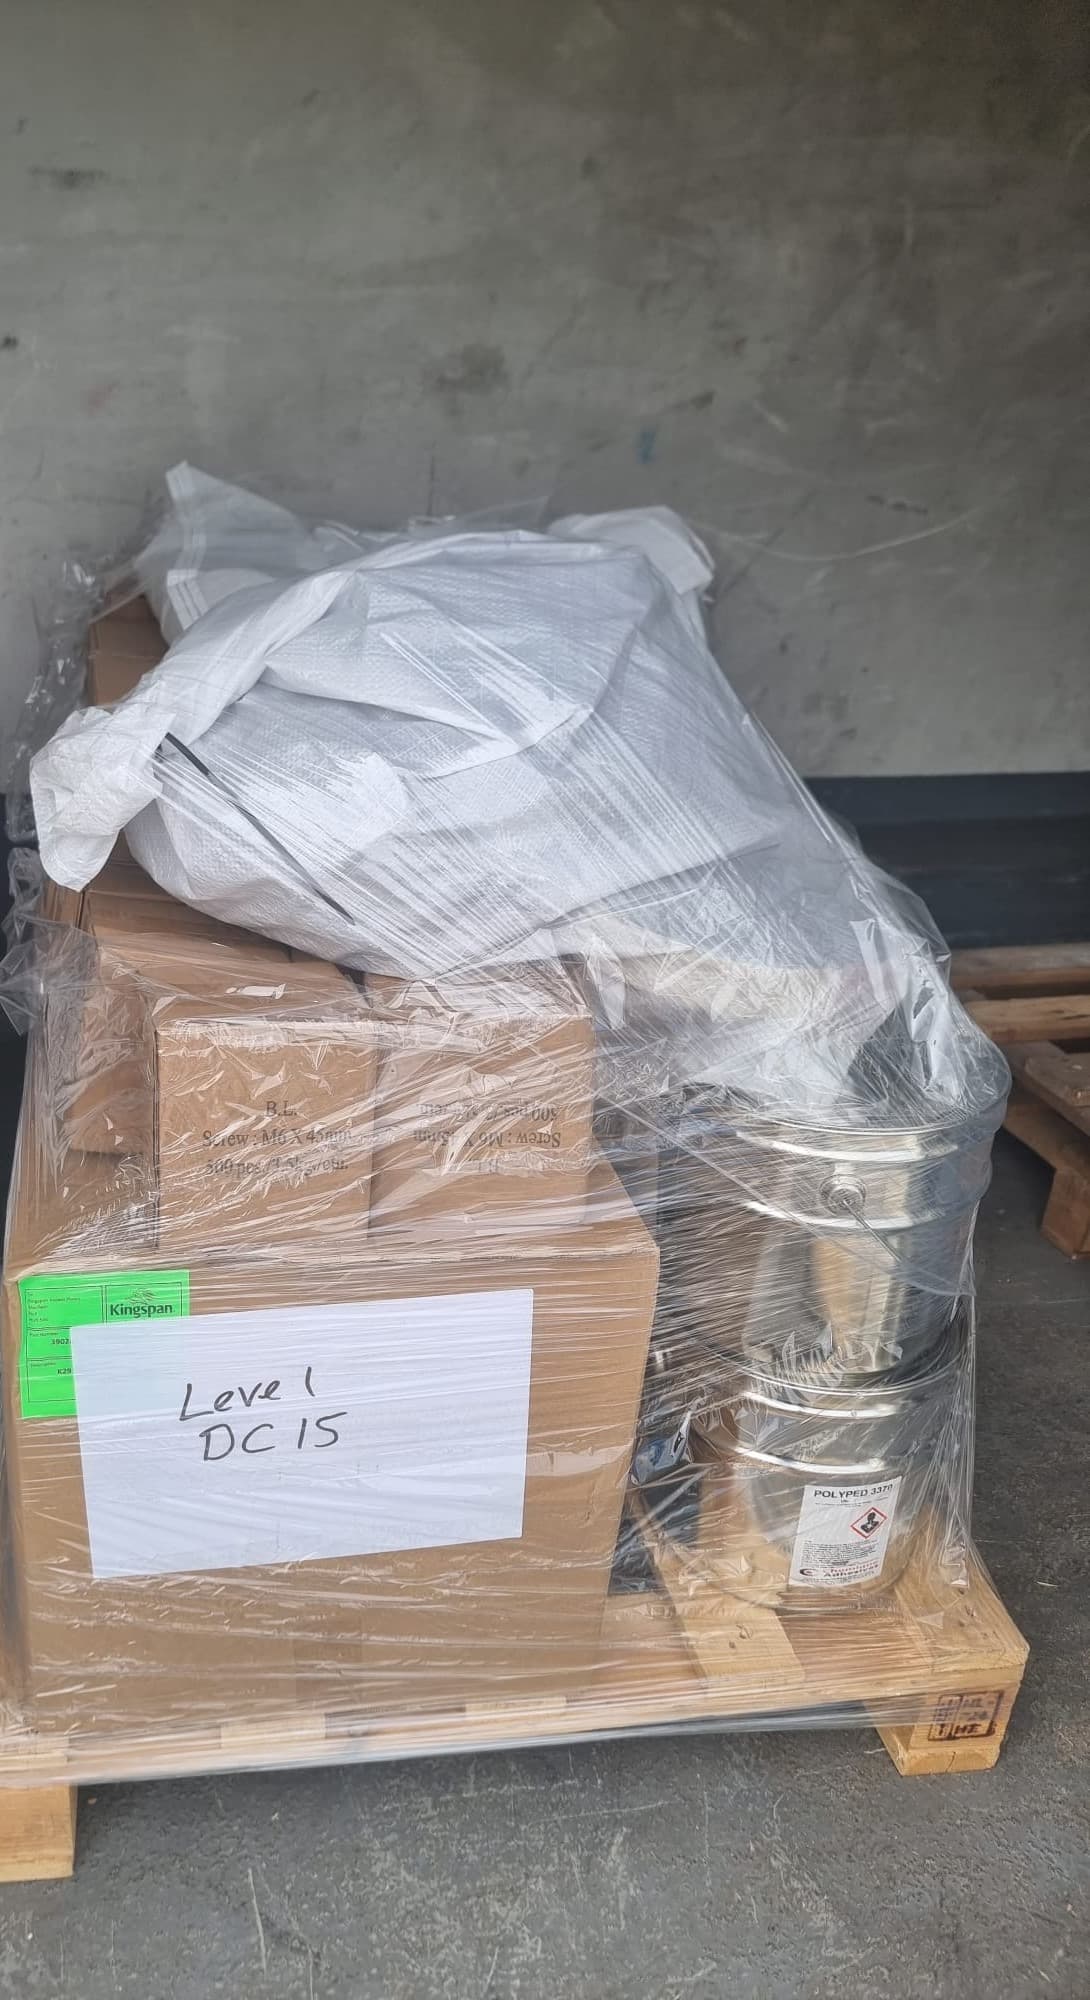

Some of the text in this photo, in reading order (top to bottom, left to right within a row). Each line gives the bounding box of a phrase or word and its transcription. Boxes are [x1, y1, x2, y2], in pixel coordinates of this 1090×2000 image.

[262, 1129, 287, 1146] M6
[110, 1303, 173, 1318] Kingspan
[814, 1489, 868, 1498] POLYPED
